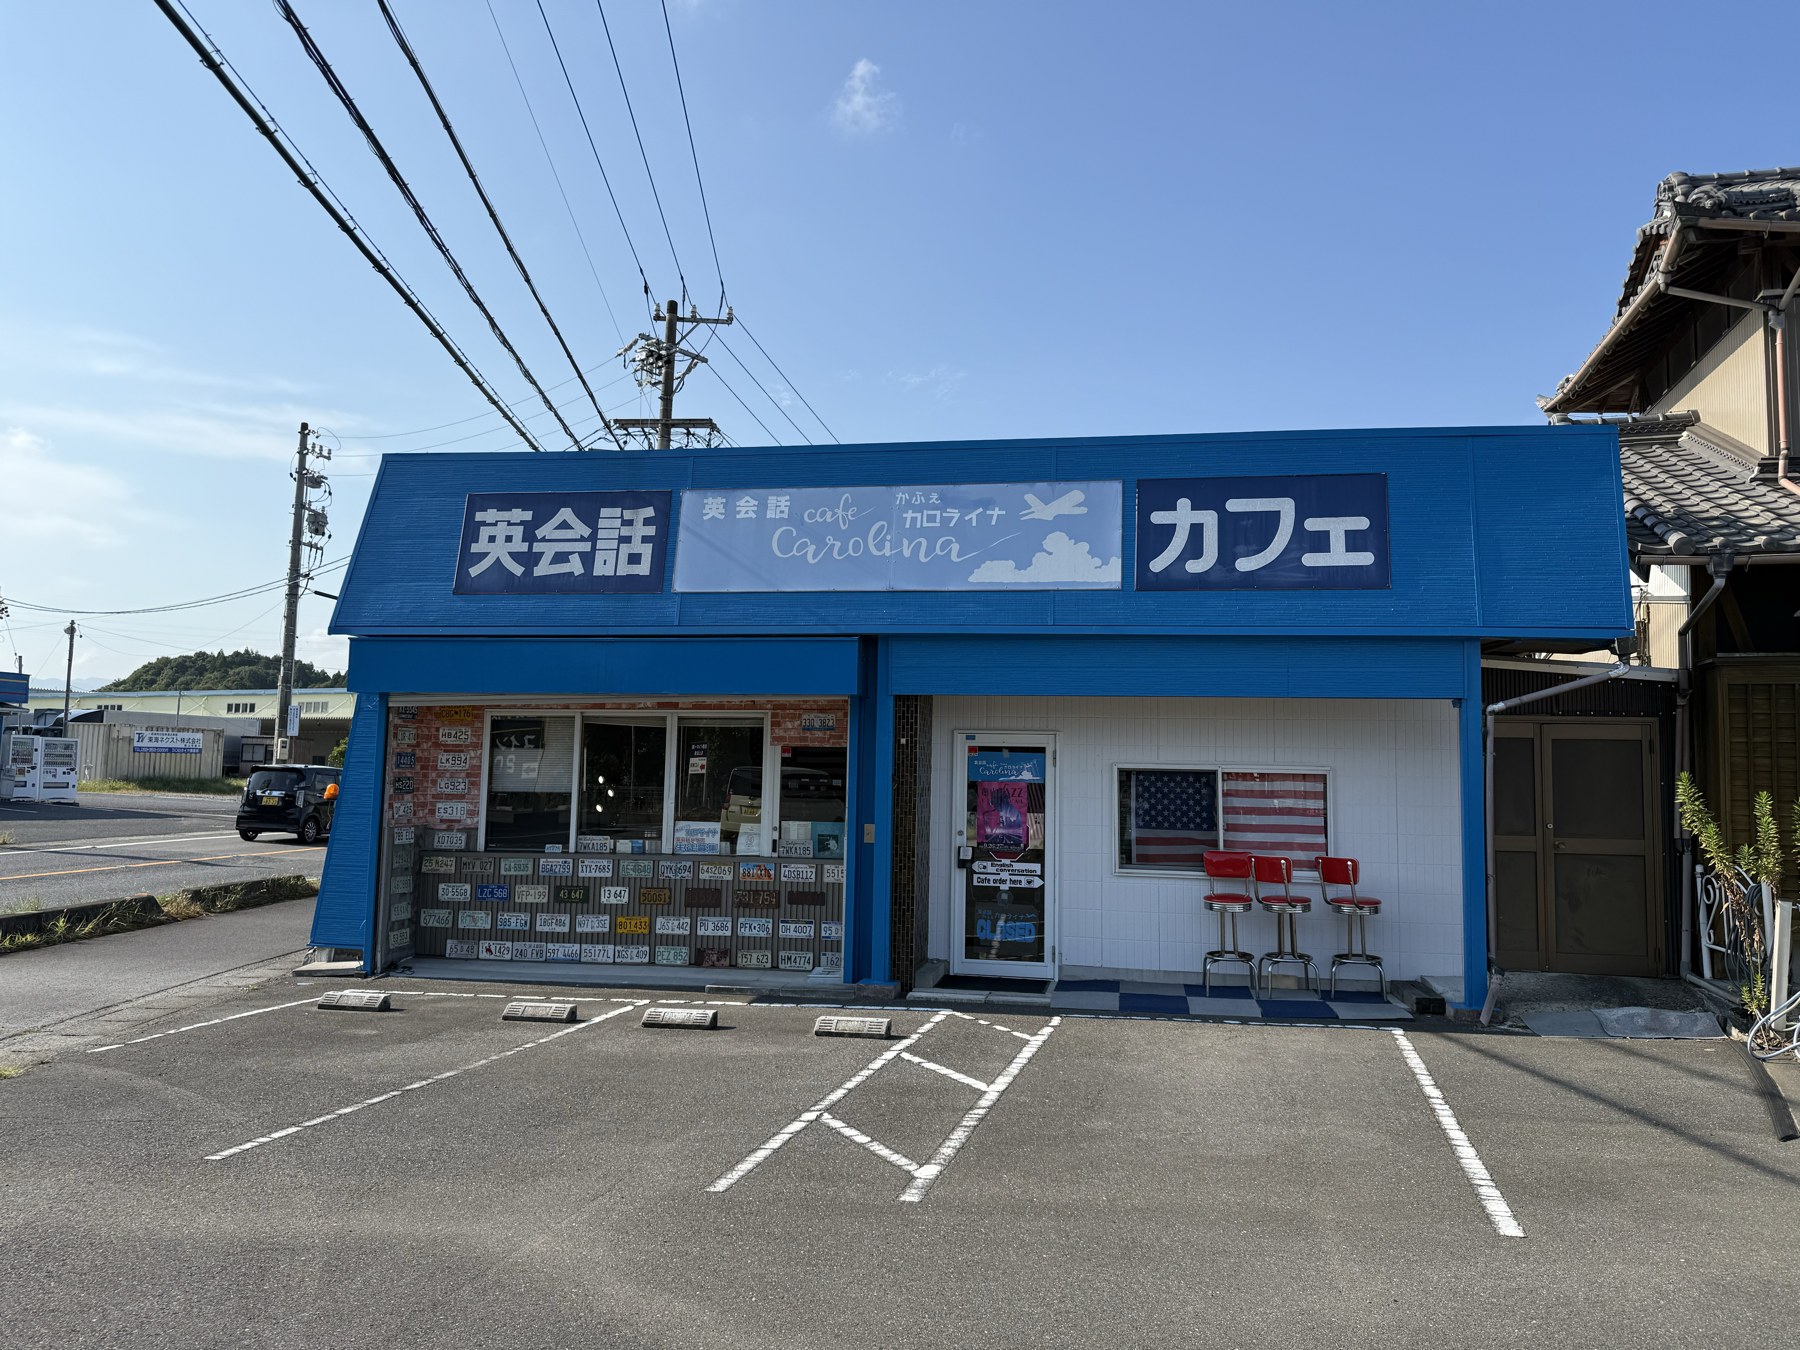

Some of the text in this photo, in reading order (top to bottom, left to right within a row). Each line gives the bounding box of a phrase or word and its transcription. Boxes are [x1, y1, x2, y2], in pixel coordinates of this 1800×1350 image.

[895, 491, 941, 505] かふぇ
[702, 495, 791, 520] 英会話
[804, 493, 877, 530] cafe
[902, 507, 1006, 529] カロライナ
[1149, 497, 1375, 574] カフェ
[468, 506, 656, 578] 英会話
[771, 520, 1023, 564] Carolina
[803, 718, 815, 728] 330
[441, 730, 470, 740] HB425
[439, 756, 468, 766] LK994
[979, 766, 1020, 776] Carolina
[438, 781, 467, 791] LG923
[437, 806, 466, 816] ES318
[1009, 877, 1023, 885] here
[603, 889, 627, 899] 13 647
[699, 922, 709, 932] PU
[466, 944, 475, 954] 48
[514, 948, 528, 958] 240
[547, 948, 560, 958] 597
[657, 951, 671, 961] PEZ
